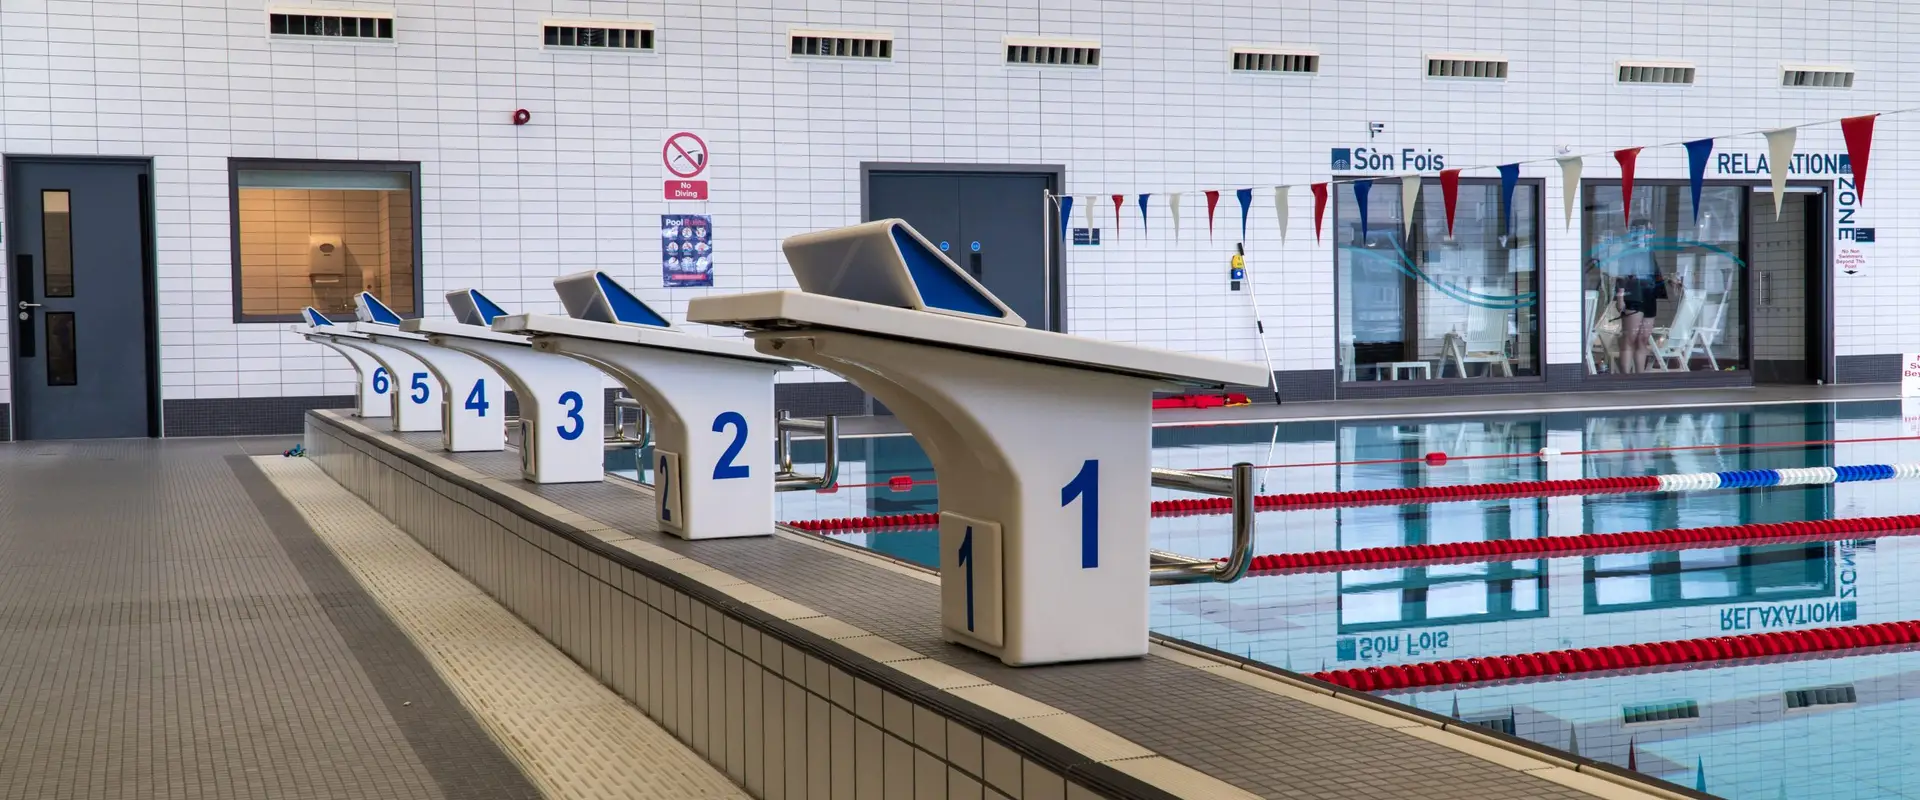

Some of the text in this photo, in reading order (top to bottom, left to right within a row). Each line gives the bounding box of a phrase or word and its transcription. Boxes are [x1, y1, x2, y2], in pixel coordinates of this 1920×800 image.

[1354, 147, 1445, 171] Sòn Fois
[1718, 153, 1837, 174] RELATION
[675, 190, 698, 198] Diving
[1838, 176, 1855, 241] ZONE
[665, 218, 683, 226] Pool
[372, 367, 389, 394] 6
[411, 372, 430, 404] 5
[464, 378, 490, 417] 4
[556, 390, 584, 440] 3
[711, 411, 750, 480] 2
[660, 455, 671, 521] 2
[1061, 459, 1099, 569] 1
[958, 525, 975, 632] 1
